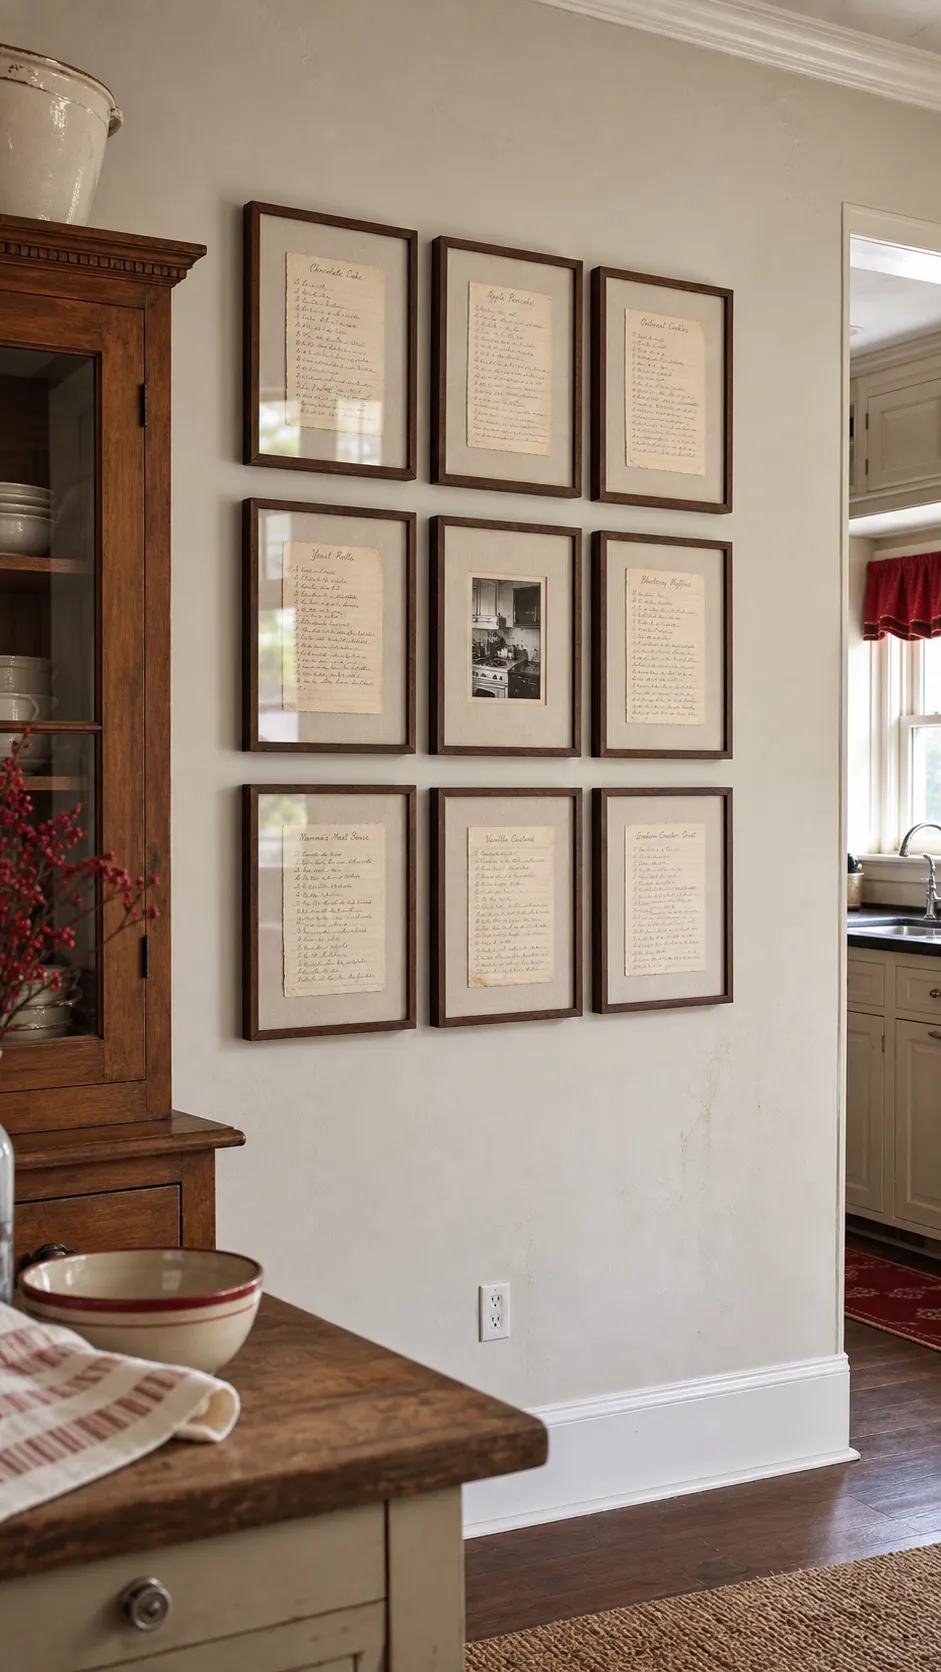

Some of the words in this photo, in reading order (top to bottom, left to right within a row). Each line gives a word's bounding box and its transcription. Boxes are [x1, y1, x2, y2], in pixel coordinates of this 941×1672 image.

[309, 263, 342, 277] Chocolate
[346, 270, 363, 280] Cake
[487, 290, 505, 303] Apple
[641, 317, 666, 329] Oatmeal
[310, 549, 332, 561] Yeast
[336, 551, 354, 561] Rolls
[331, 832, 348, 841] Meat
[350, 831, 370, 841] Sauce
[486, 834, 508, 843] Vanilla
[510, 833, 535, 843] Custard
[636, 831, 657, 840] Graham
